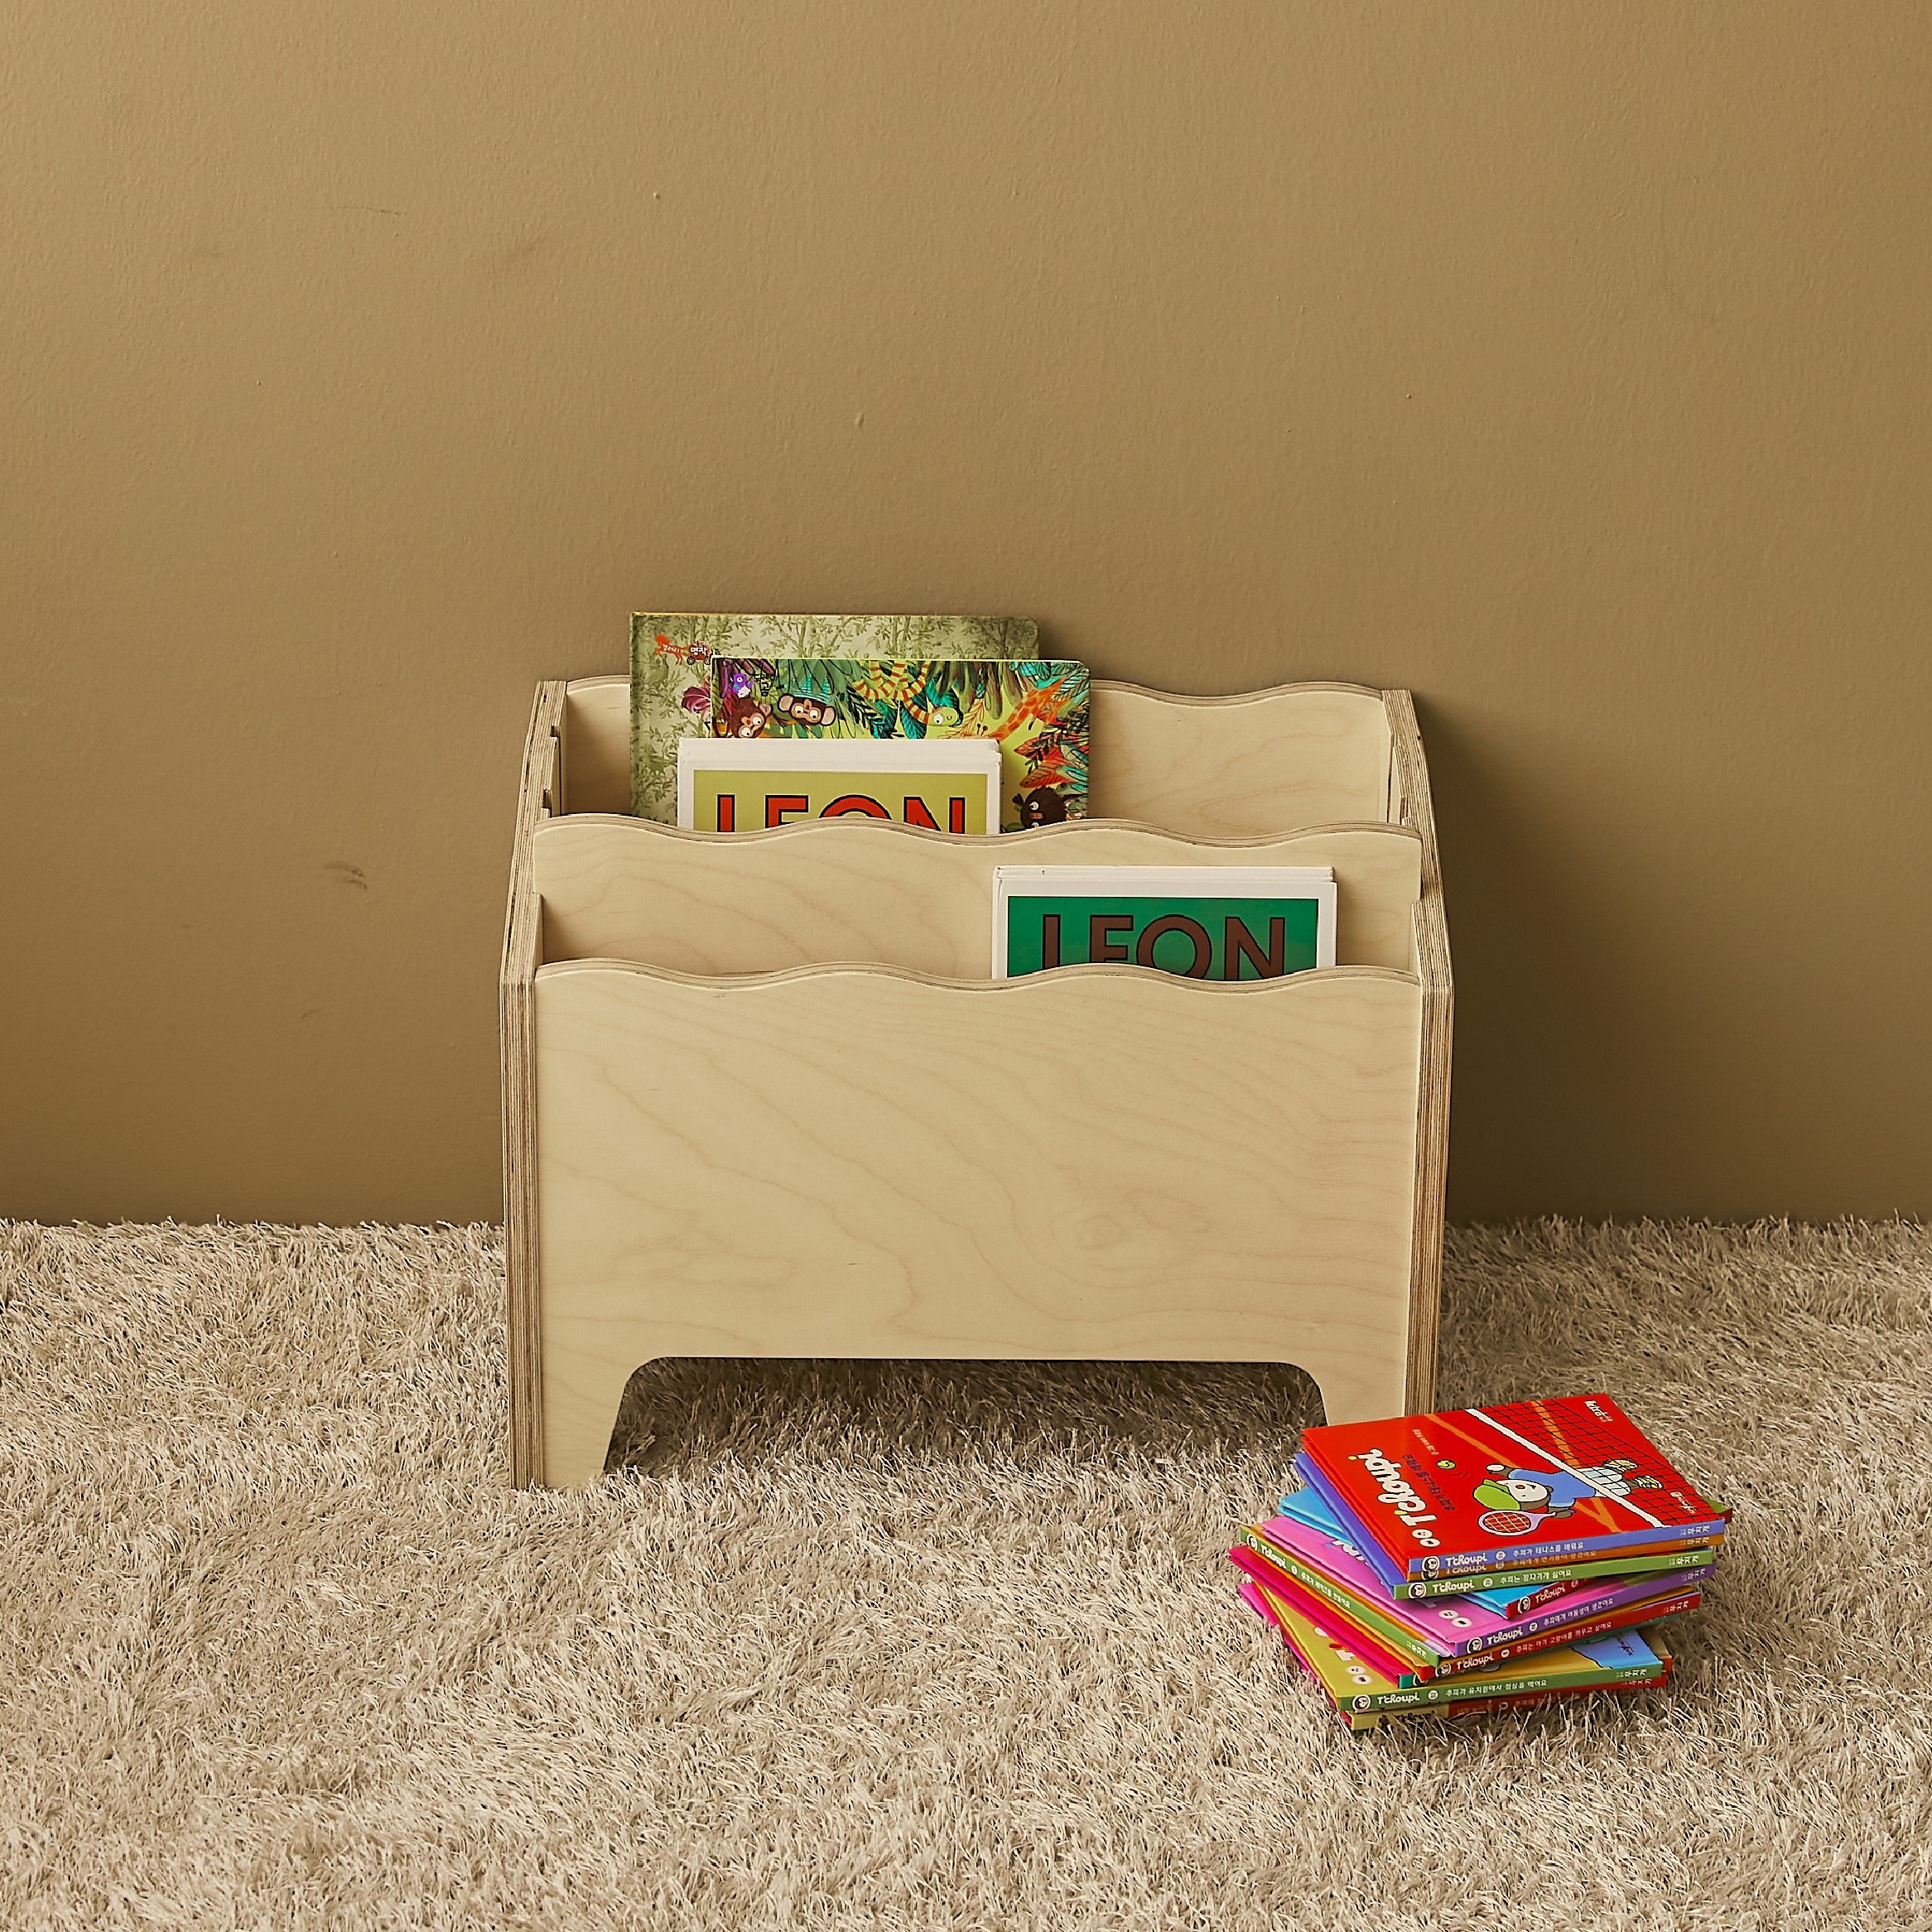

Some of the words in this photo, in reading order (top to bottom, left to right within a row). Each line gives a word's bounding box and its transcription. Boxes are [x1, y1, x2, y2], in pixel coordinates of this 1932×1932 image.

[690, 645, 708, 656] 명작
[1347, 1448, 1437, 1526] T'choupi
[1513, 1549, 1533, 1557] 추피가
[1445, 1553, 1488, 1567] T'choupi
[1432, 1579, 1475, 1592] T'choupi
[1501, 1575, 1520, 1585] 추피는
[1487, 1626, 1523, 1645] T'choupi
[1377, 1692, 1420, 1705] T'choupi
